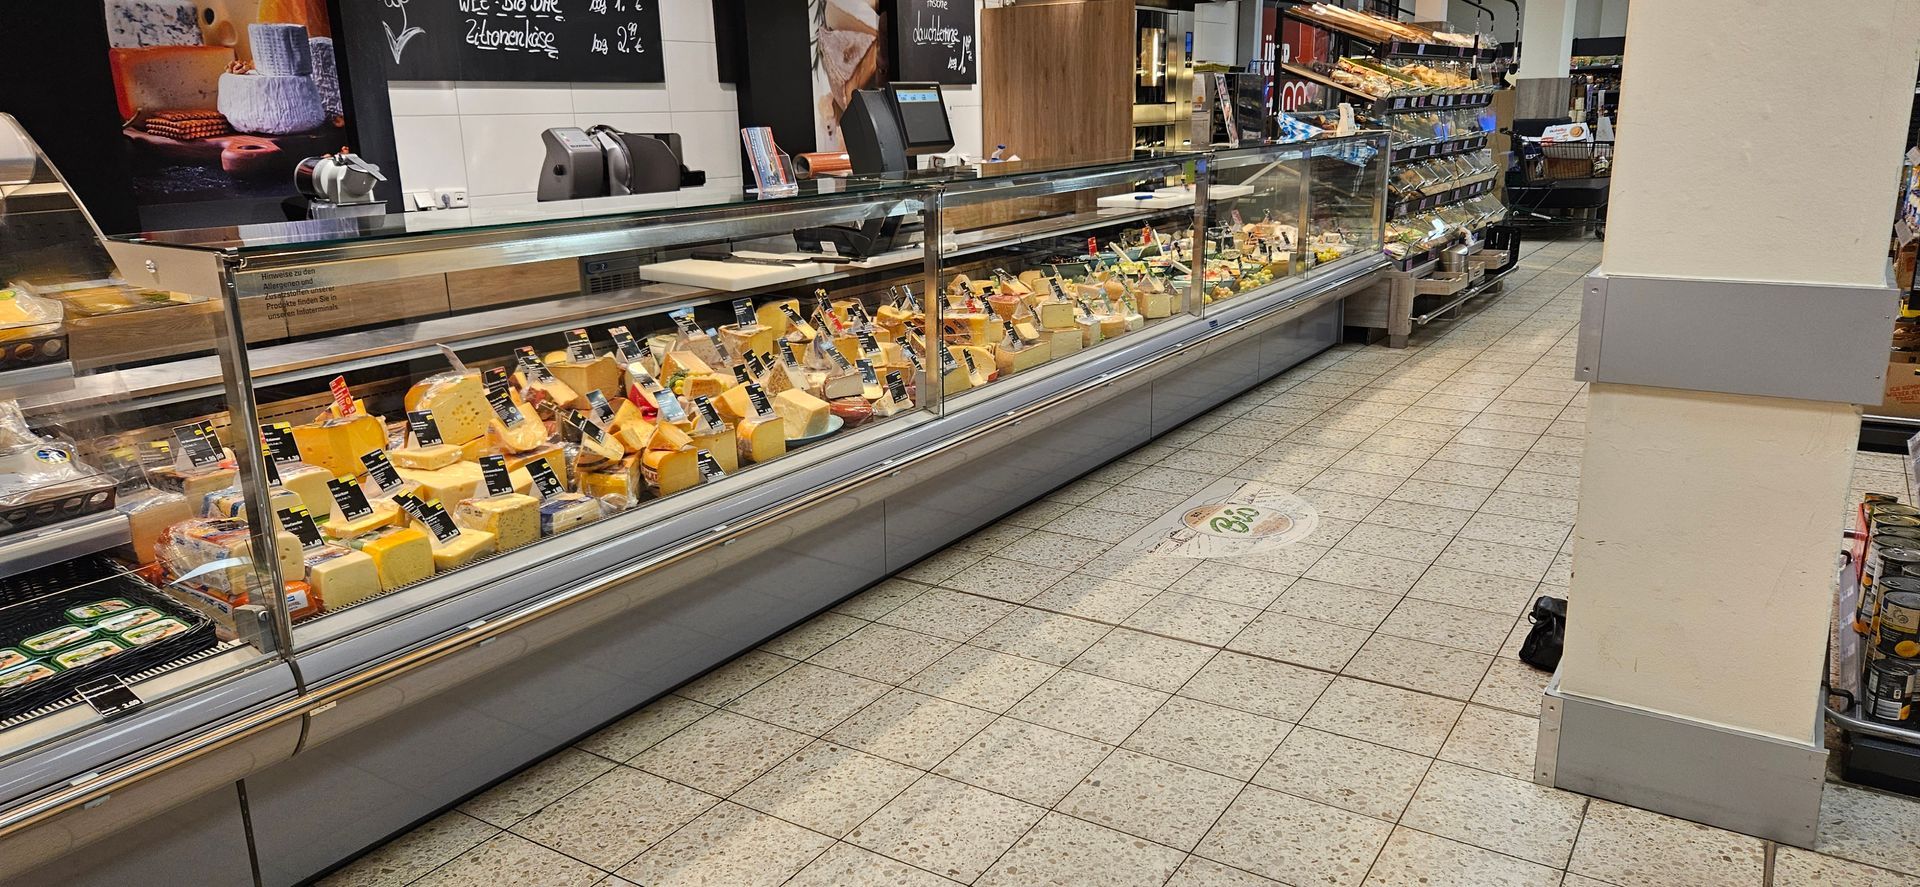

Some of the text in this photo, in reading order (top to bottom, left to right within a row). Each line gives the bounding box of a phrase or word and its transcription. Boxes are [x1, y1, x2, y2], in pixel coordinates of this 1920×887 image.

[465, 18, 558, 50] Zitronenkäse
[261, 271, 293, 280] Hinweise
[263, 281, 300, 291] Allergenen
[265, 289, 309, 300] Zusatzstoffen
[266, 301, 296, 310] Produkte
[297, 297, 318, 306] finden
[268, 311, 295, 320] unseren
[1210, 507, 1260, 534] Bio
